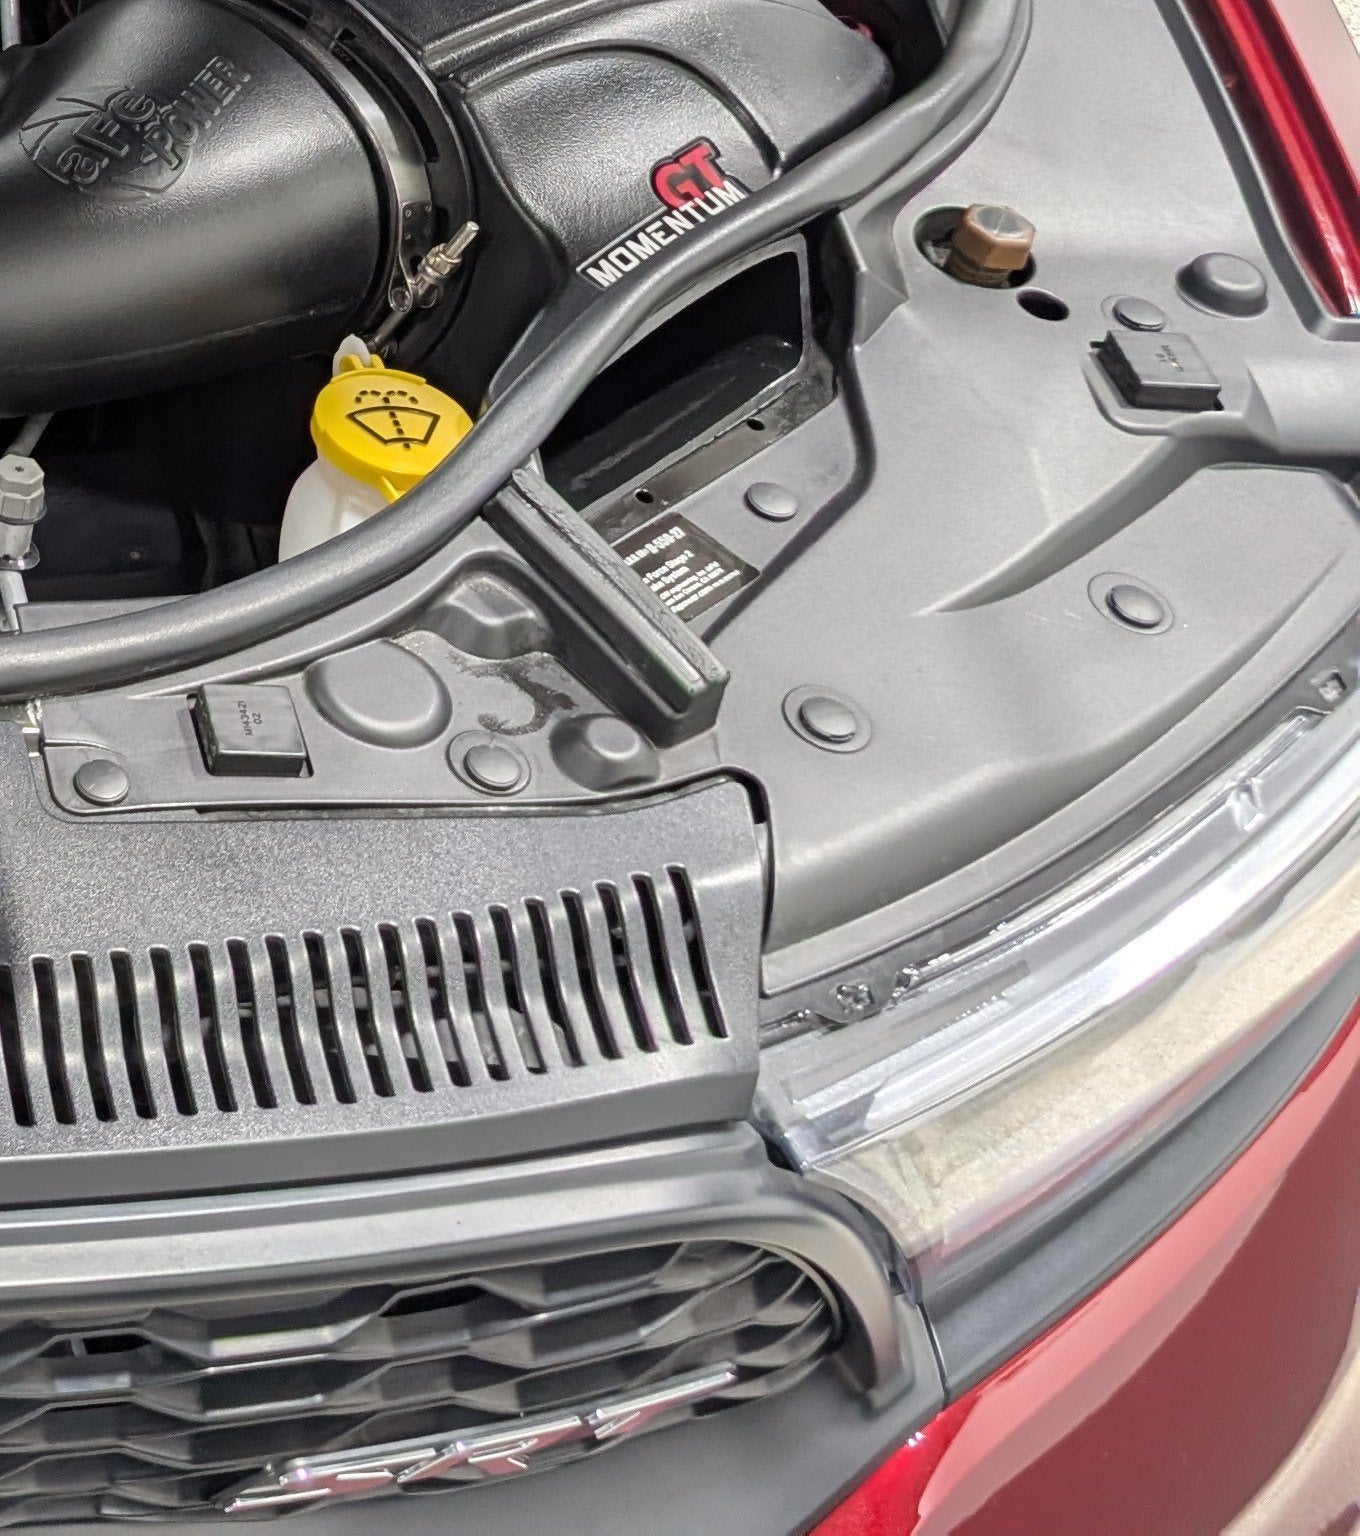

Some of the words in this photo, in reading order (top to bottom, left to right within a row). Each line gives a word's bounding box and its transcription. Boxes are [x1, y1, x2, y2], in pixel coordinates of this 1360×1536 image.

[143, 55, 252, 170] POWER
[654, 143, 725, 210] GT
[586, 180, 747, 287] MOMENTUM
